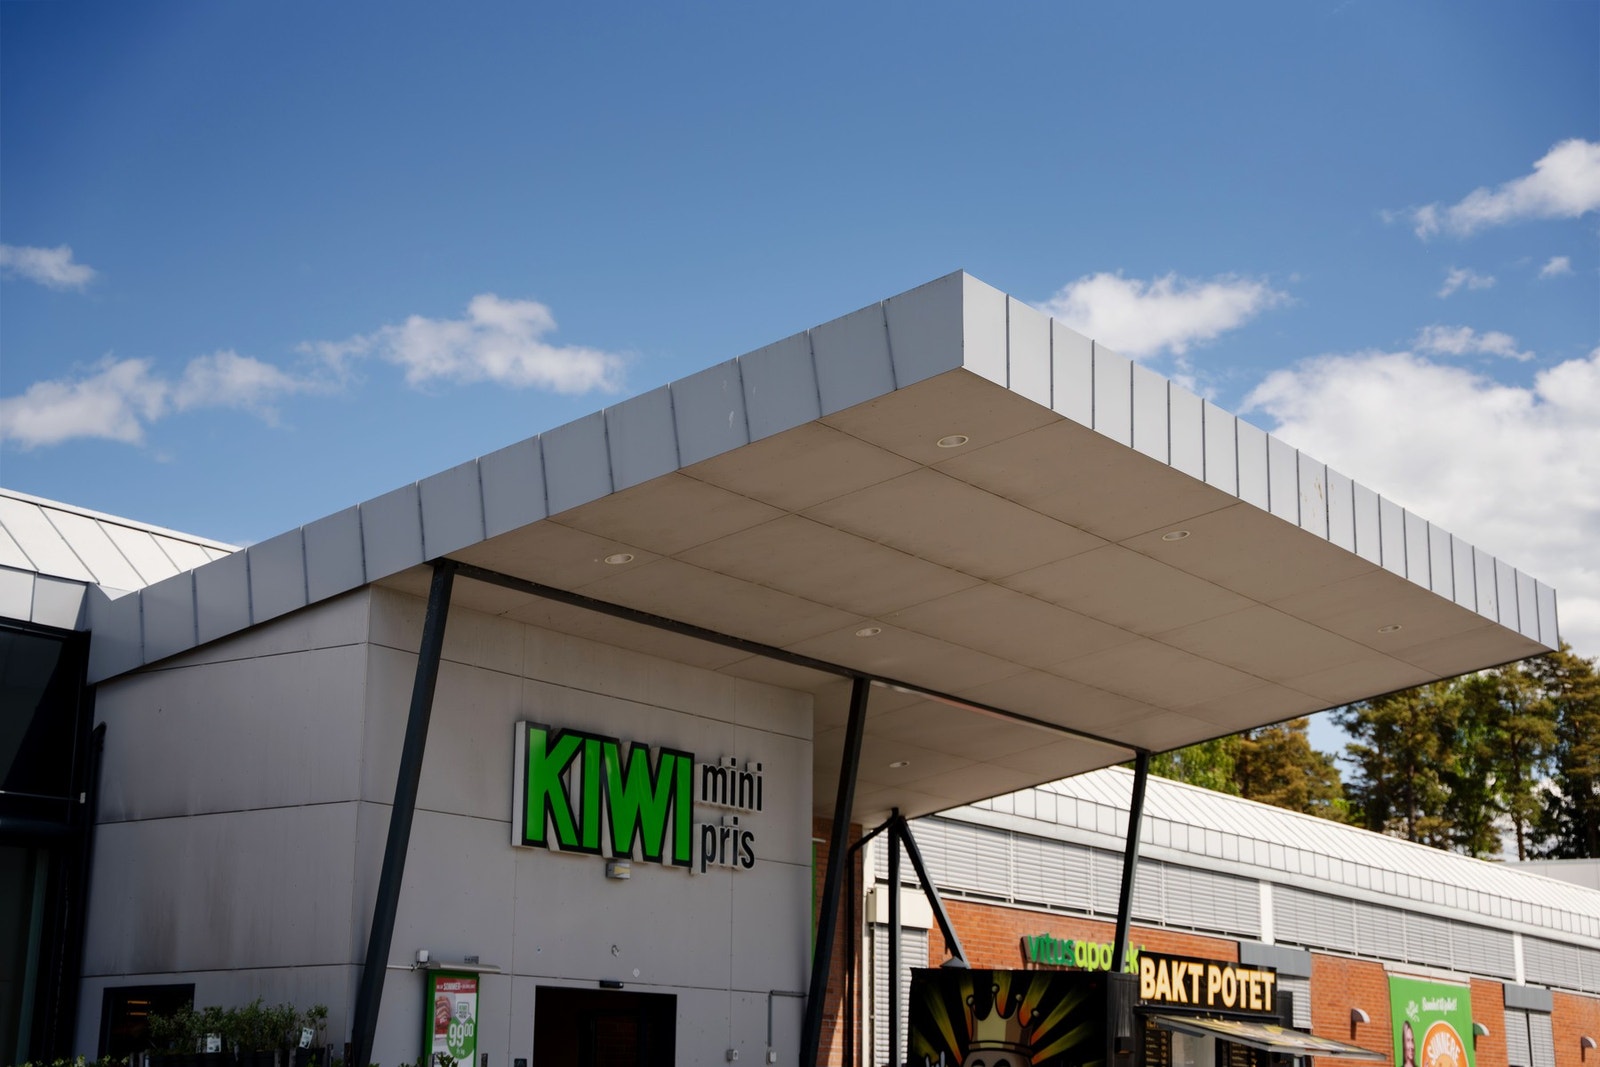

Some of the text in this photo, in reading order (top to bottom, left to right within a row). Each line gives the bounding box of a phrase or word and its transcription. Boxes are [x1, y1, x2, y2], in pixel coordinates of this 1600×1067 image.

[519, 720, 695, 867] KIWI
[701, 757, 763, 811] mini
[700, 816, 755, 873] pris
[1027, 932, 1140, 974] vitusapok
[1140, 956, 1275, 1011] BAKT POTET
